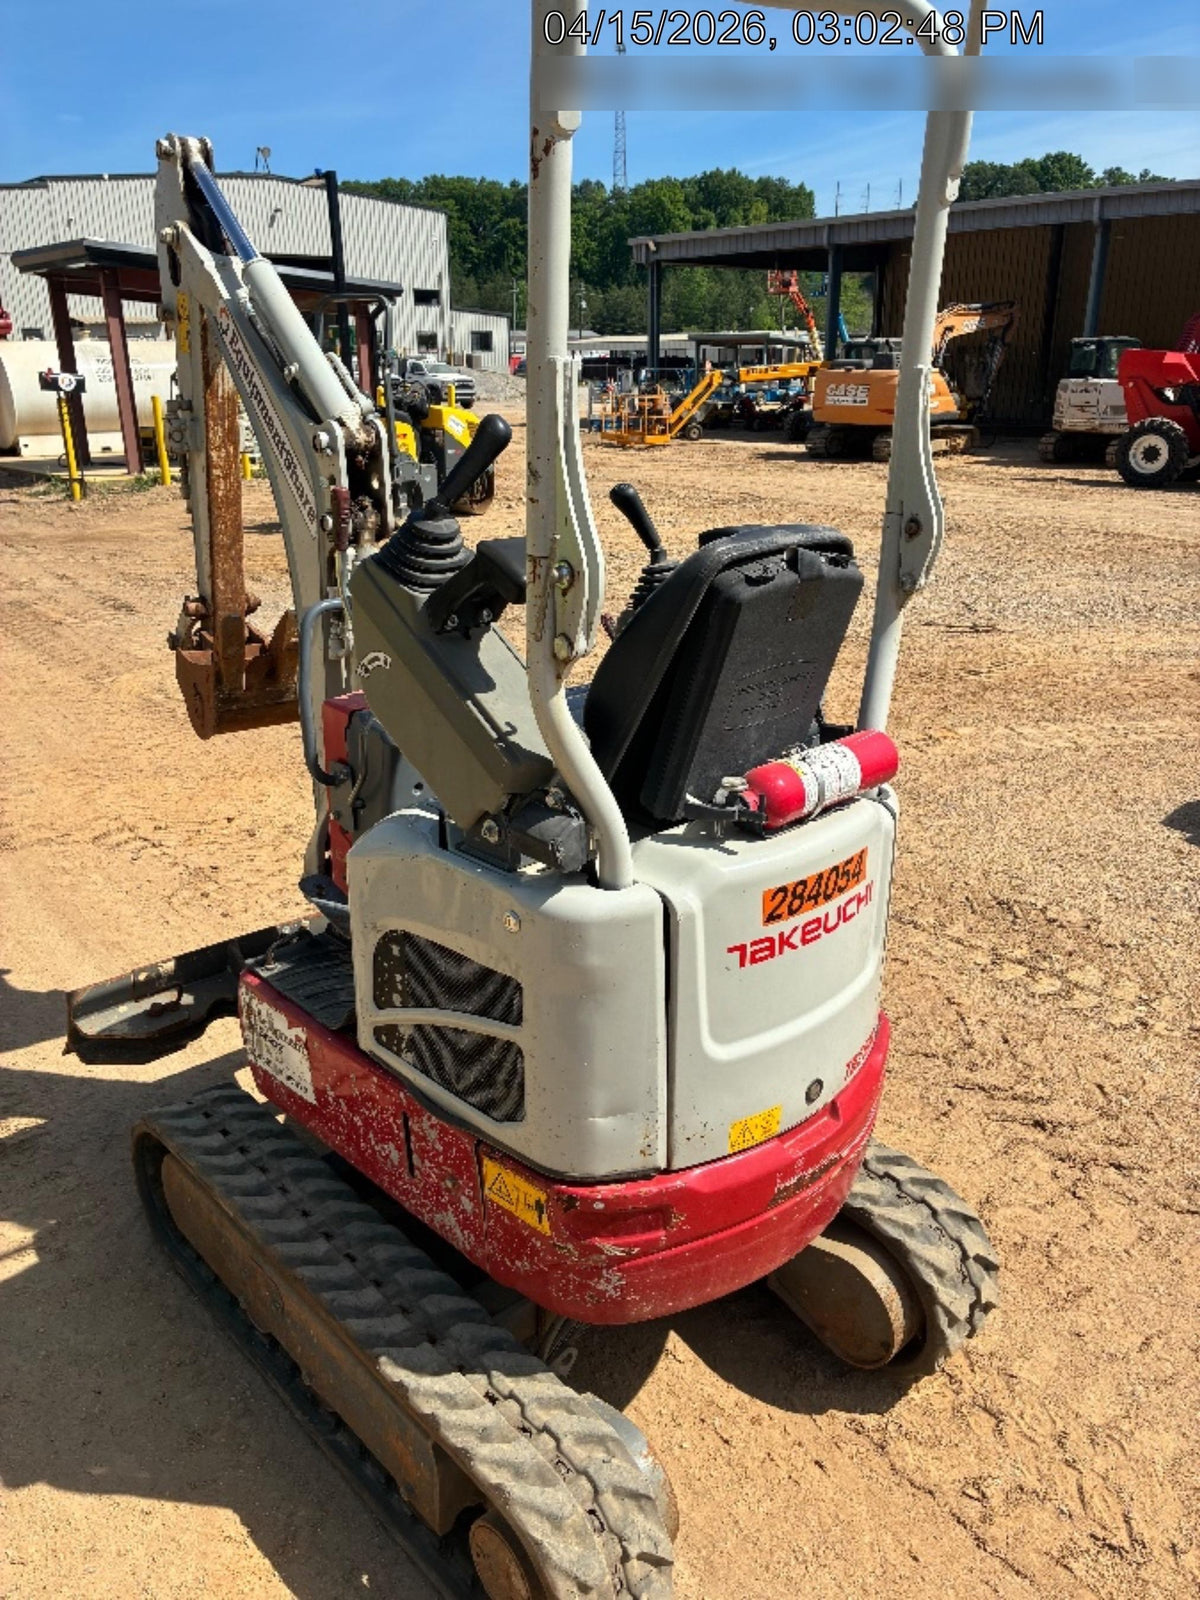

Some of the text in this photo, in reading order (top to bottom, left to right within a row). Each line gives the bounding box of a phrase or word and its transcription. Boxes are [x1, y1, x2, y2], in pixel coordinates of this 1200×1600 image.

[826, 383, 870, 397] CASE
[727, 879, 874, 969] TAKEUCHI
[764, 849, 865, 924] 284054
